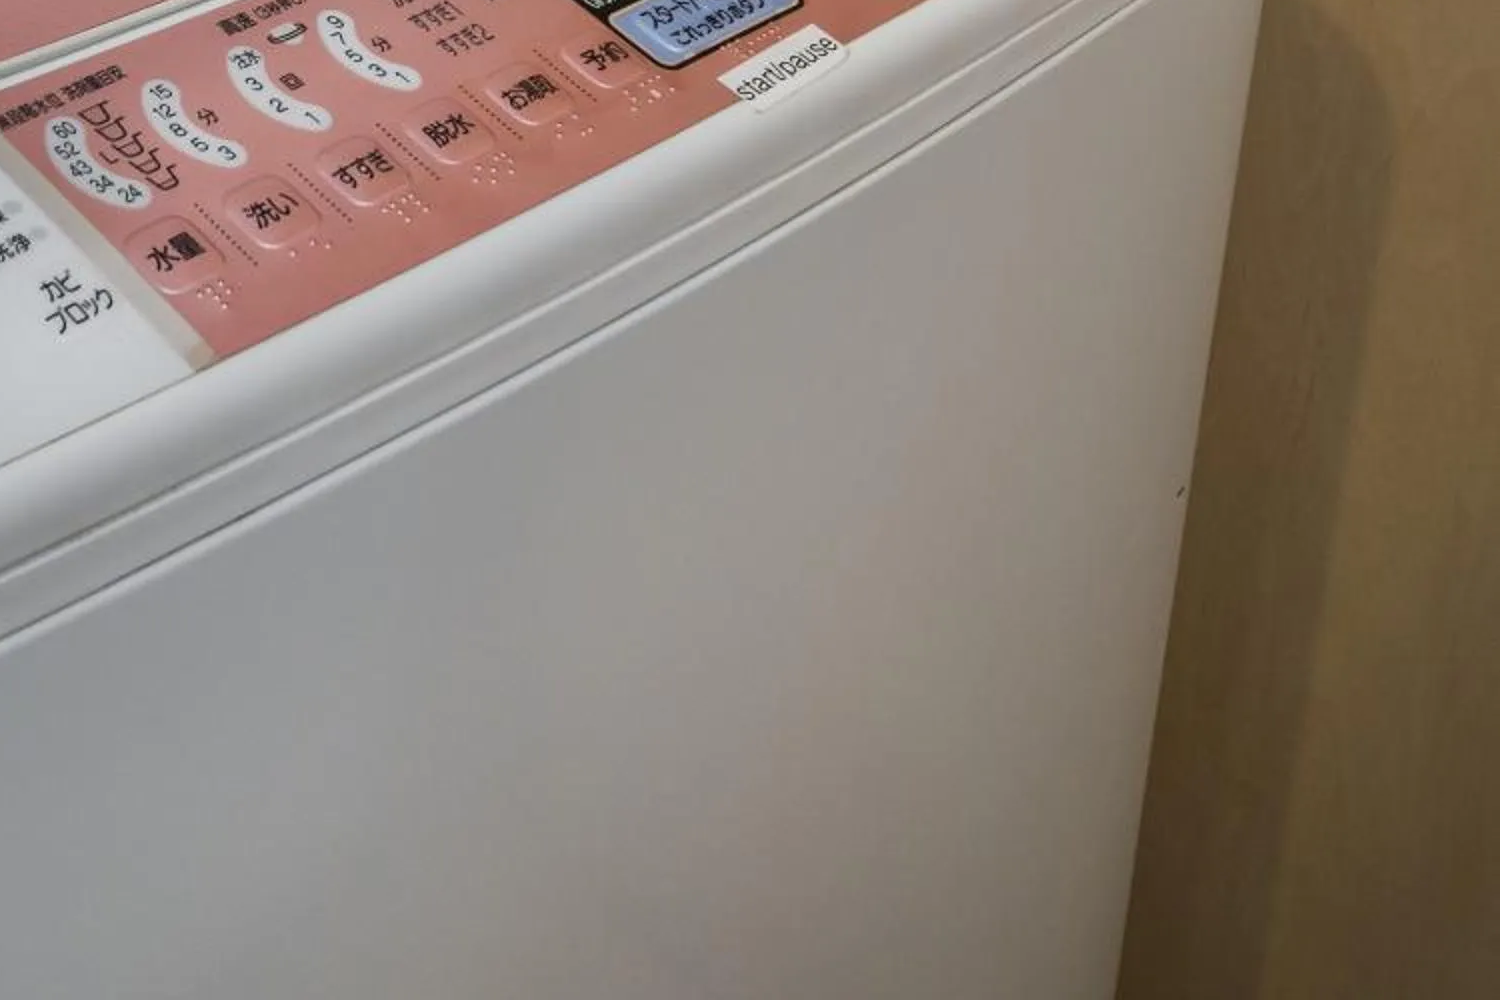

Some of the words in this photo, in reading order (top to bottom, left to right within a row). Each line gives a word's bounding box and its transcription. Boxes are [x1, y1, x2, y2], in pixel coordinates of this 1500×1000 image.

[326, 15, 345, 29] 9
[330, 31, 346, 45] 7
[371, 36, 392, 53] 分
[344, 48, 363, 63] 5
[581, 41, 629, 71] 予約
[368, 62, 387, 77] 3
[736, 34, 838, 101] start/pause
[244, 77, 263, 91] 3
[394, 71, 411, 83] 1
[150, 83, 173, 99] 15
[152, 103, 177, 120] 12
[269, 97, 289, 113] 2
[196, 107, 219, 127] 分
[304, 111, 321, 124] 1
[52, 121, 77, 139] 60
[169, 123, 188, 138] 8
[422, 113, 476, 149] 脱水
[54, 141, 80, 160] 52
[190, 137, 209, 152] 5
[217, 145, 237, 161] 3
[69, 159, 93, 177] 43
[332, 148, 395, 189] すすぎ
[89, 175, 114, 193] 34
[117, 184, 142, 203] 24
[242, 192, 299, 230] 洗い
[147, 231, 207, 272] 水量
[39, 268, 82, 302] カビ
[44, 288, 114, 334] ブロック
